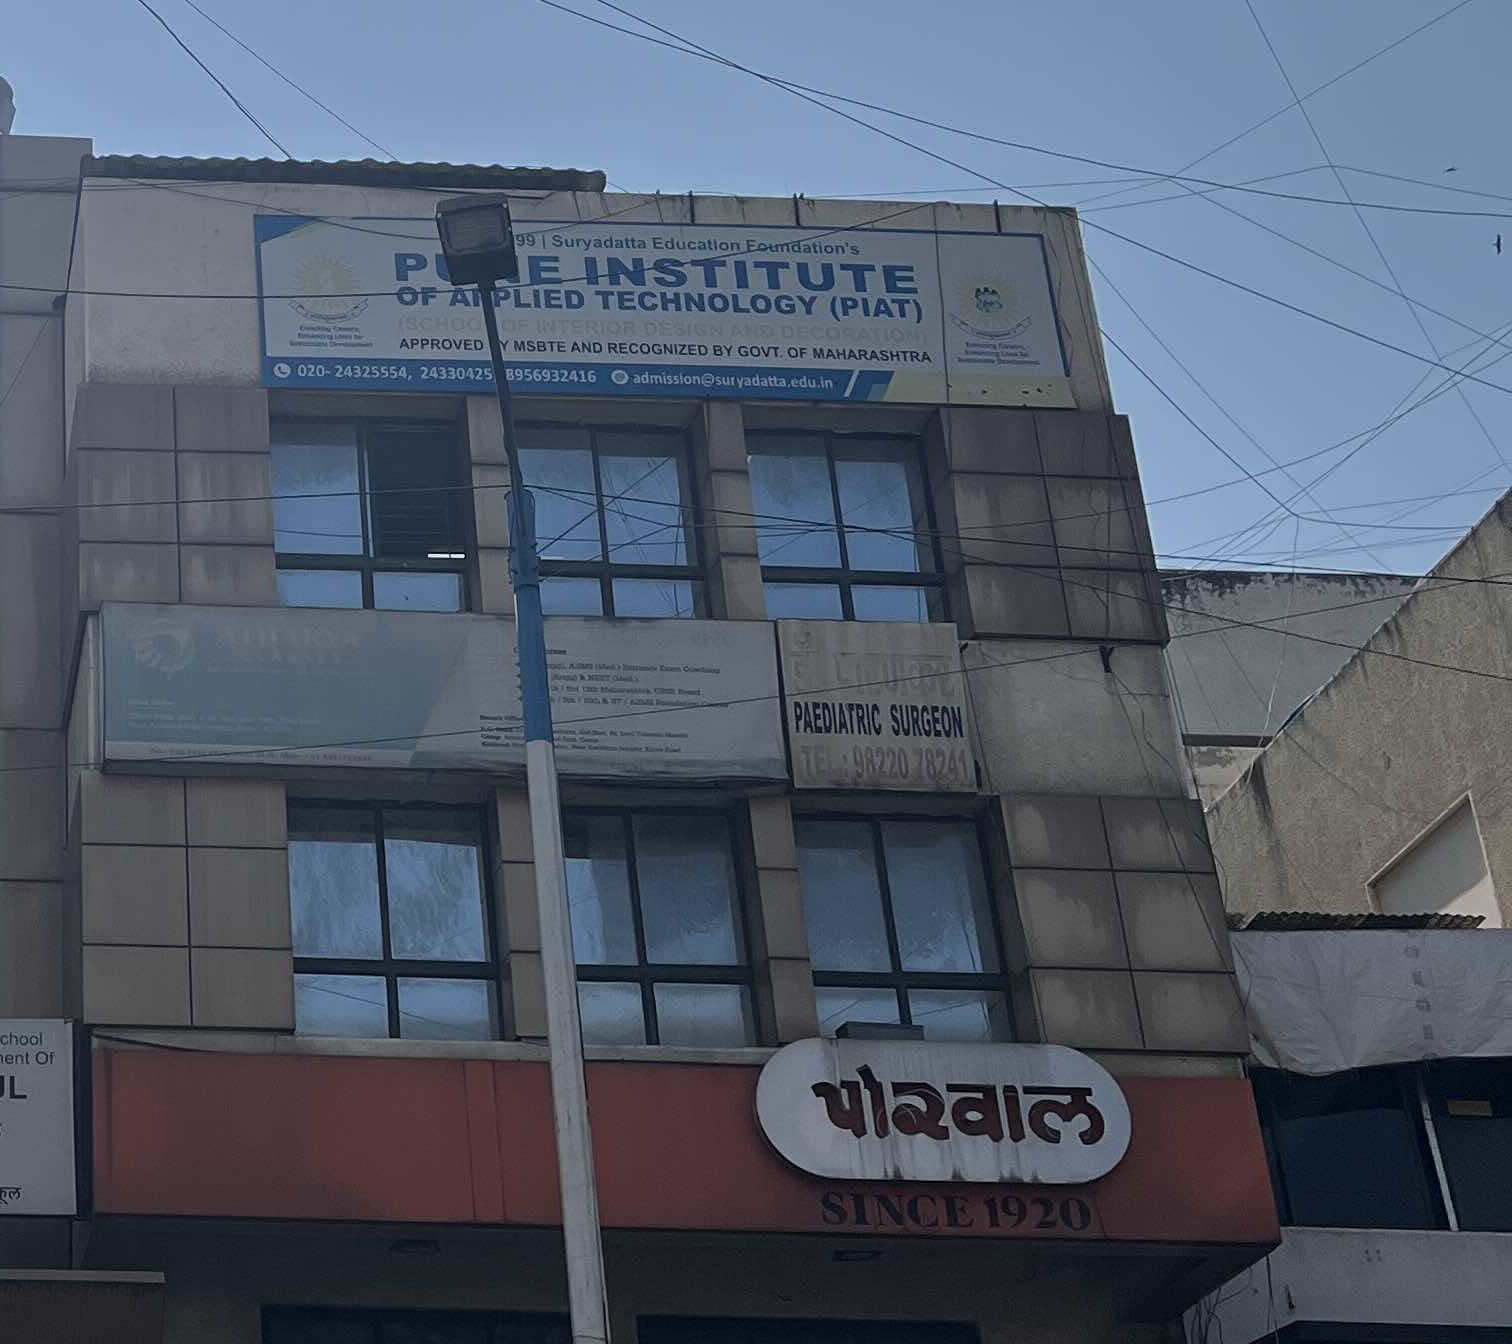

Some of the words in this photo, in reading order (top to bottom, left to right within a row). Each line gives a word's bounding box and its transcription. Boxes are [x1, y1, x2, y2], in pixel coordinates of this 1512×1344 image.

[551, 234, 647, 252] Suryadatta
[652, 237, 741, 254] Education
[746, 239, 860, 257] Foundation's
[584, 255, 920, 295] INSTITUTE
[396, 286, 438, 306] OF
[595, 289, 818, 316] TECHNOLOGY
[830, 295, 923, 323] (PIAT)
[399, 338, 484, 351] APPROVED
[514, 341, 567, 353] MSBTE
[571, 341, 603, 354] AND
[607, 342, 709, 358] RECOGNIZED
[713, 344, 733, 358] BY
[738, 344, 780, 359] GOVT.
[787, 346, 809, 360] OF
[813, 347, 932, 364] MAHARASHTRA
[505, 367, 597, 383] 8956932416
[632, 369, 834, 390] admission@suryadatta.edu.in
[792, 700, 883, 737] PAEDIATRIC
[889, 703, 965, 739] SURGEON
[35, 1050, 57, 1066] Of
[821, 1190, 974, 1229] SINCE
[983, 1194, 1092, 1232] 1920
